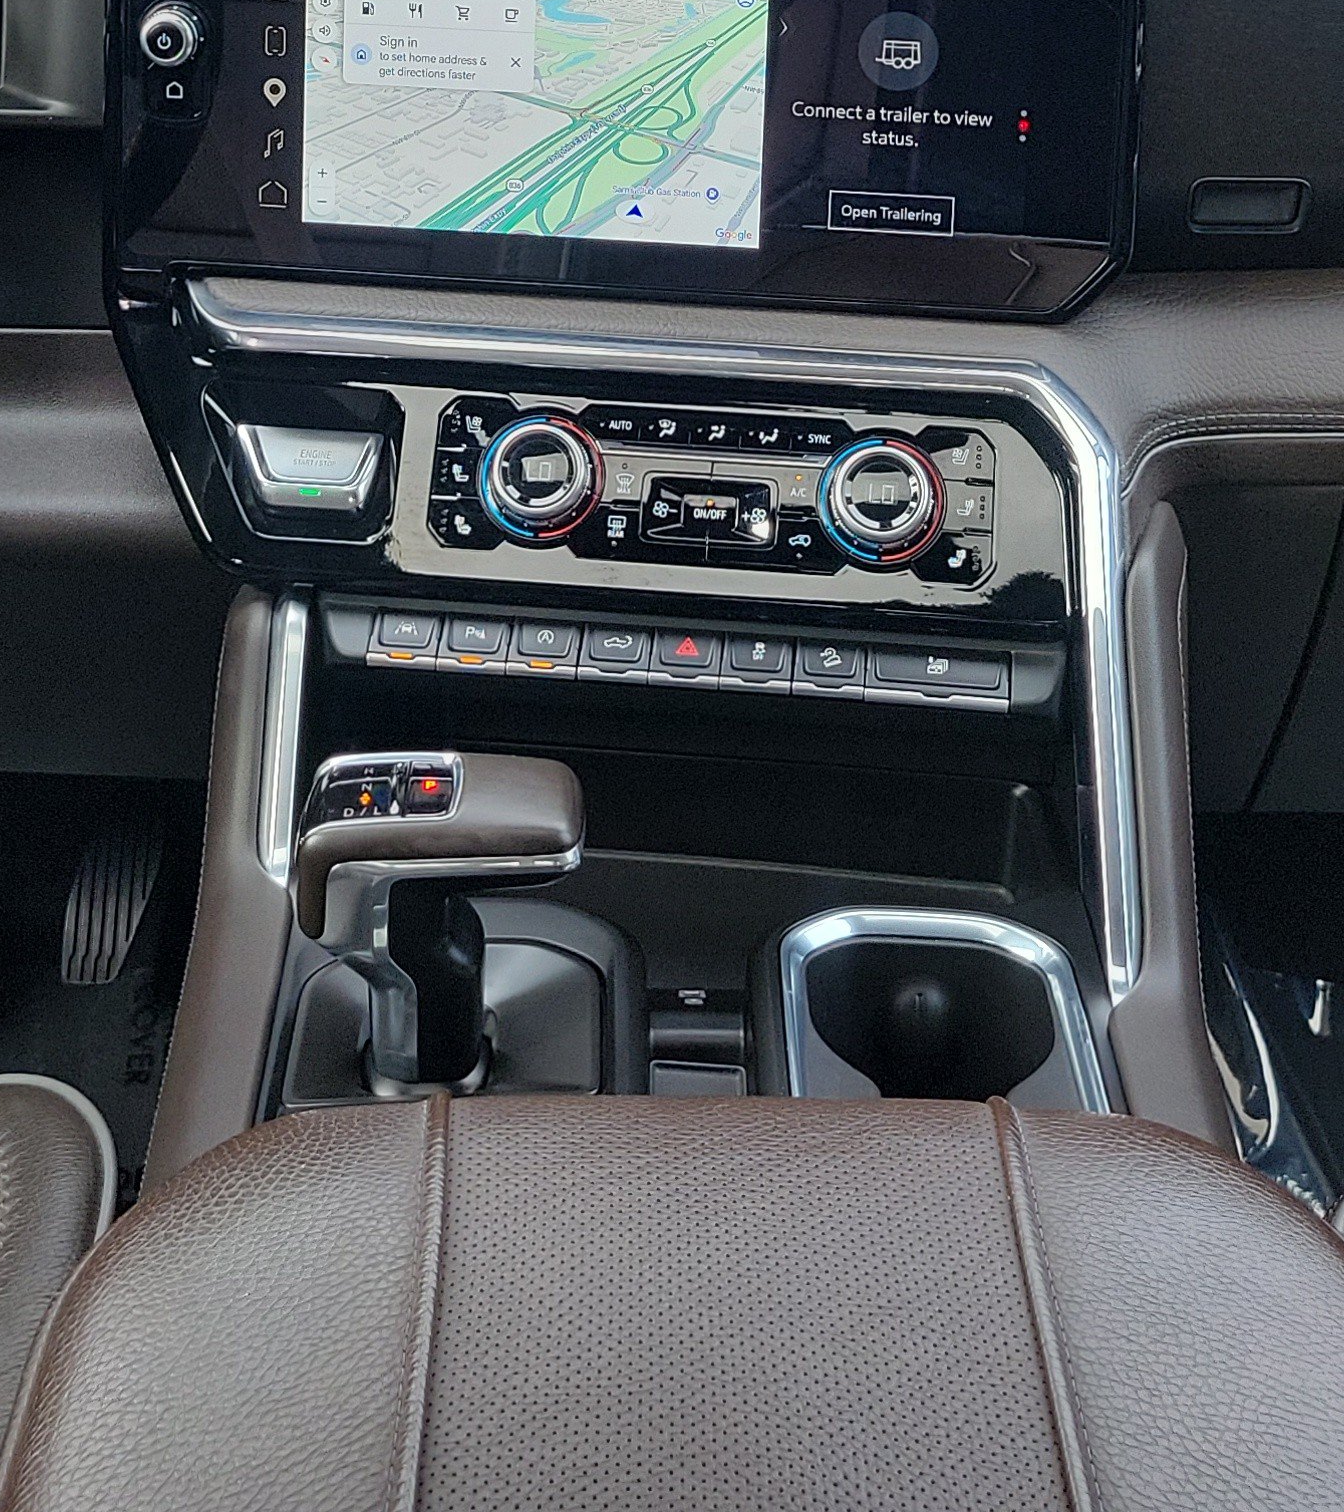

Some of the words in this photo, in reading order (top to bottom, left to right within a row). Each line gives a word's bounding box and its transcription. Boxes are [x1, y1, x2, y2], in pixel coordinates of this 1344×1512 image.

[379, 35, 405, 49] Sign
[407, 36, 418, 48] in
[379, 52, 389, 62] to
[391, 52, 406, 63] set
[409, 53, 436, 63] home
[438, 54, 477, 66] address
[479, 55, 487, 66] &
[379, 67, 395, 78] get
[397, 66, 446, 79] directions
[448, 69, 476, 80] faster
[791, 100, 862, 120] Connect
[865, 109, 875, 121] a
[879, 105, 930, 123] trailer
[933, 108, 951, 125] to
[954, 110, 993, 127] view
[862, 130, 919, 147] status.
[656, 188, 672, 197] Gas
[674, 188, 701, 198] Station
[841, 204, 877, 221] Open
[879, 205, 942, 225] Trailering
[715, 227, 752, 242] Google
[608, 419, 633, 431] AUTO
[807, 433, 832, 445] SYNC
[300, 448, 333, 460] ENGINE
[790, 487, 807, 498] A/C
[693, 508, 728, 521] ON/OFF
[424, 780, 438, 790] P
[343, 807, 355, 817] D
